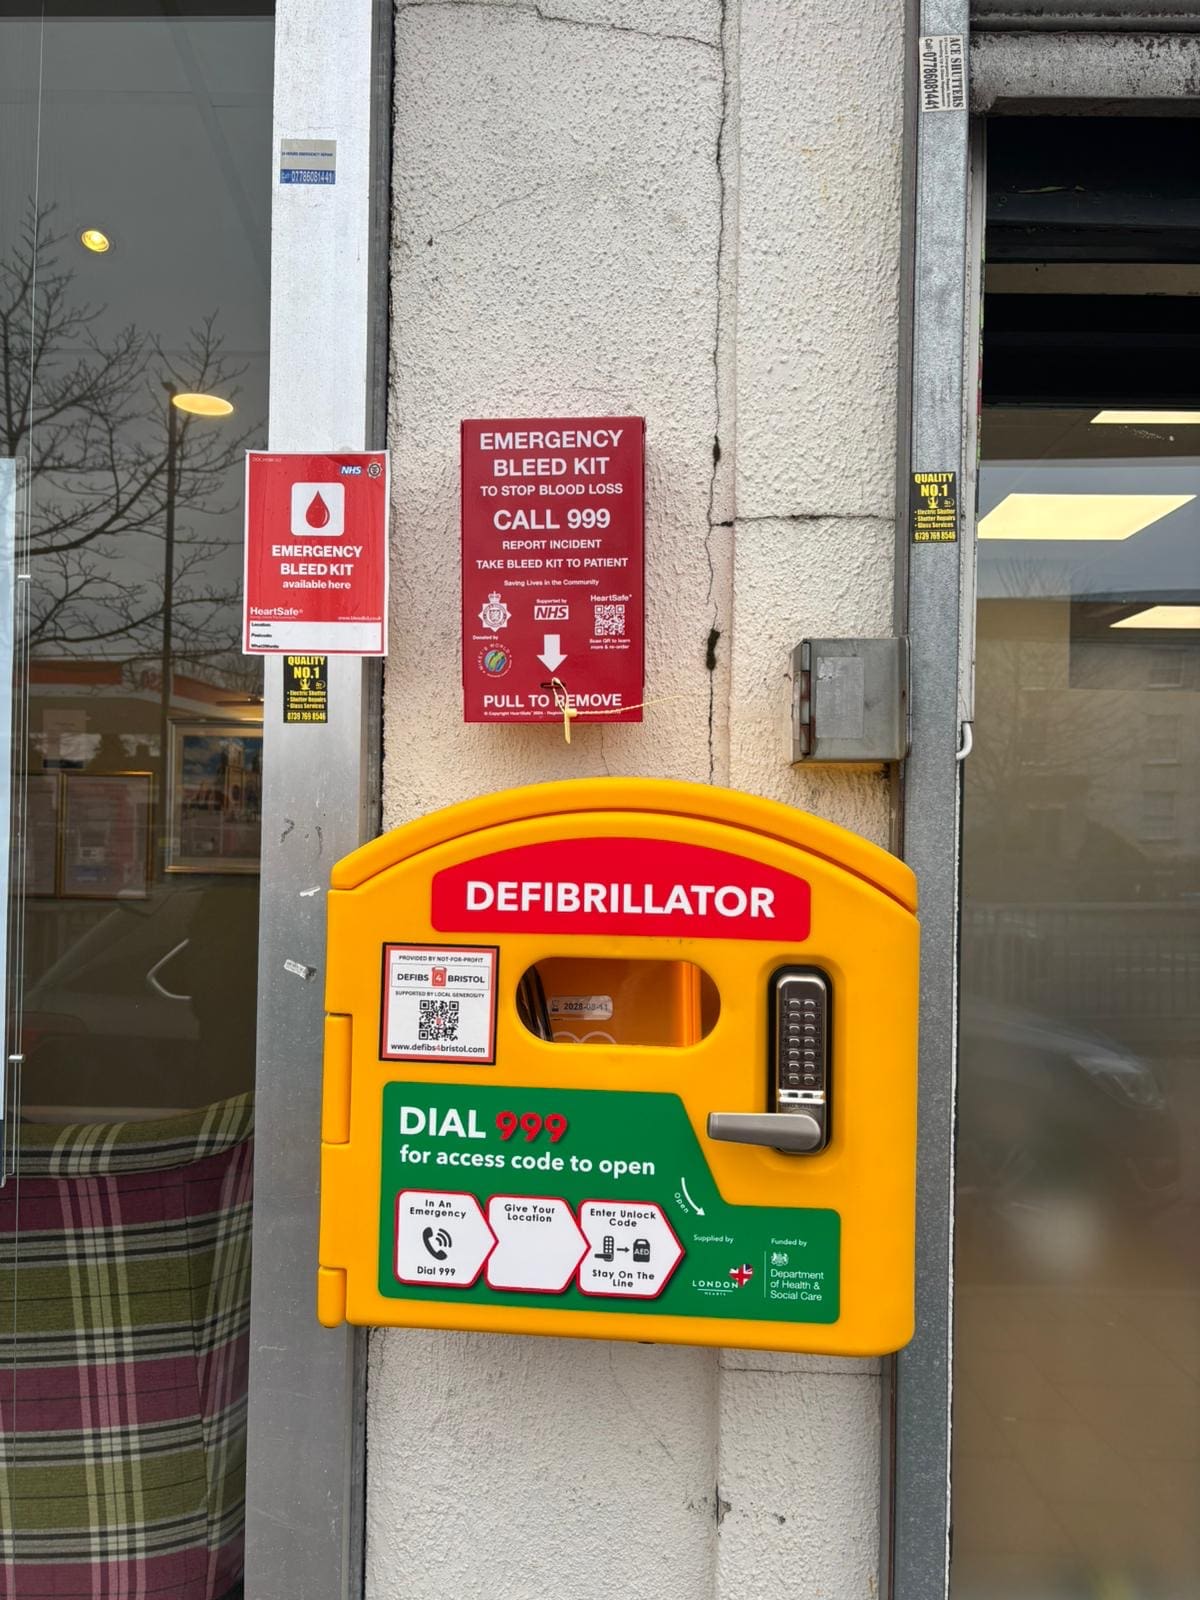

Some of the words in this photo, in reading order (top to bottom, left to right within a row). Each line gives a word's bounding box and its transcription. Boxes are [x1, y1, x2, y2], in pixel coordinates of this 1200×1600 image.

[949, 37, 961, 55] ACE
[922, 52, 939, 110] 07786081441
[950, 57, 963, 107] SHUTTERS
[480, 429, 624, 450] EMERGENCY
[341, 465, 361, 475] NHS
[493, 457, 567, 477] BLEED
[574, 457, 610, 475] KIT
[915, 473, 953, 484] QUALITY
[480, 486, 498, 496] TO
[501, 485, 536, 496] STOP
[539, 484, 585, 496] BLOOD
[588, 483, 623, 495] LOSS
[921, 484, 948, 497] NO.1
[493, 509, 560, 530] CALL
[567, 508, 610, 529] 999
[502, 540, 547, 550] REPORT
[550, 539, 602, 549] INCIDENT
[271, 544, 363, 558] EMERGENCY
[476, 560, 504, 569] TAKE
[507, 559, 543, 569] BLEED
[546, 559, 563, 568] KIT
[566, 558, 581, 568] TO
[584, 558, 628, 567] PATIENT
[280, 563, 328, 575] BLEED
[330, 564, 354, 576] KIT
[282, 580, 326, 589] available
[328, 580, 351, 590] here
[563, 579, 599, 587] Community
[536, 607, 567, 618] NHS
[288, 656, 325, 666] QUALITY
[294, 666, 320, 679] NO.1
[484, 695, 524, 708] PULL
[528, 694, 550, 707] TO
[555, 694, 622, 707] REMOVE
[465, 881, 776, 918] DEFIBRILLATOR
[448, 975, 485, 983] BRISTOL
[391, 1043, 485, 1053] www.defibs4bristol.com
[400, 1106, 486, 1138] DIAL
[495, 1111, 568, 1142] 999
[400, 1144, 431, 1163] for
[436, 1152, 504, 1168] access
[511, 1152, 564, 1171] code
[570, 1155, 592, 1172] to
[598, 1159, 655, 1179] open
[439, 1200, 452, 1208] An
[674, 1192, 689, 1213] Open
[410, 1207, 466, 1219] Emergency
[504, 1204, 528, 1212] Give
[532, 1205, 555, 1214] Your
[590, 1209, 616, 1217] Enter
[620, 1210, 656, 1219] Unlock
[507, 1213, 552, 1222] Location
[609, 1218, 637, 1227] Code
[693, 1234, 724, 1243] Supplied
[725, 1235, 734, 1244] by
[799, 1239, 807, 1247] by
[634, 1248, 649, 1256] AED
[417, 1266, 436, 1275] Dial
[439, 1268, 456, 1276] 999
[592, 1269, 614, 1279] Stay
[619, 1271, 633, 1279] On
[637, 1272, 655, 1280] The
[770, 1269, 824, 1280] Department
[613, 1279, 633, 1288] Line
[692, 1280, 738, 1288] LONDON
[770, 1280, 779, 1288] of
[782, 1280, 811, 1289] Health
[814, 1282, 820, 1290] &
[770, 1290, 798, 1300] Social
[801, 1292, 822, 1300] Care
